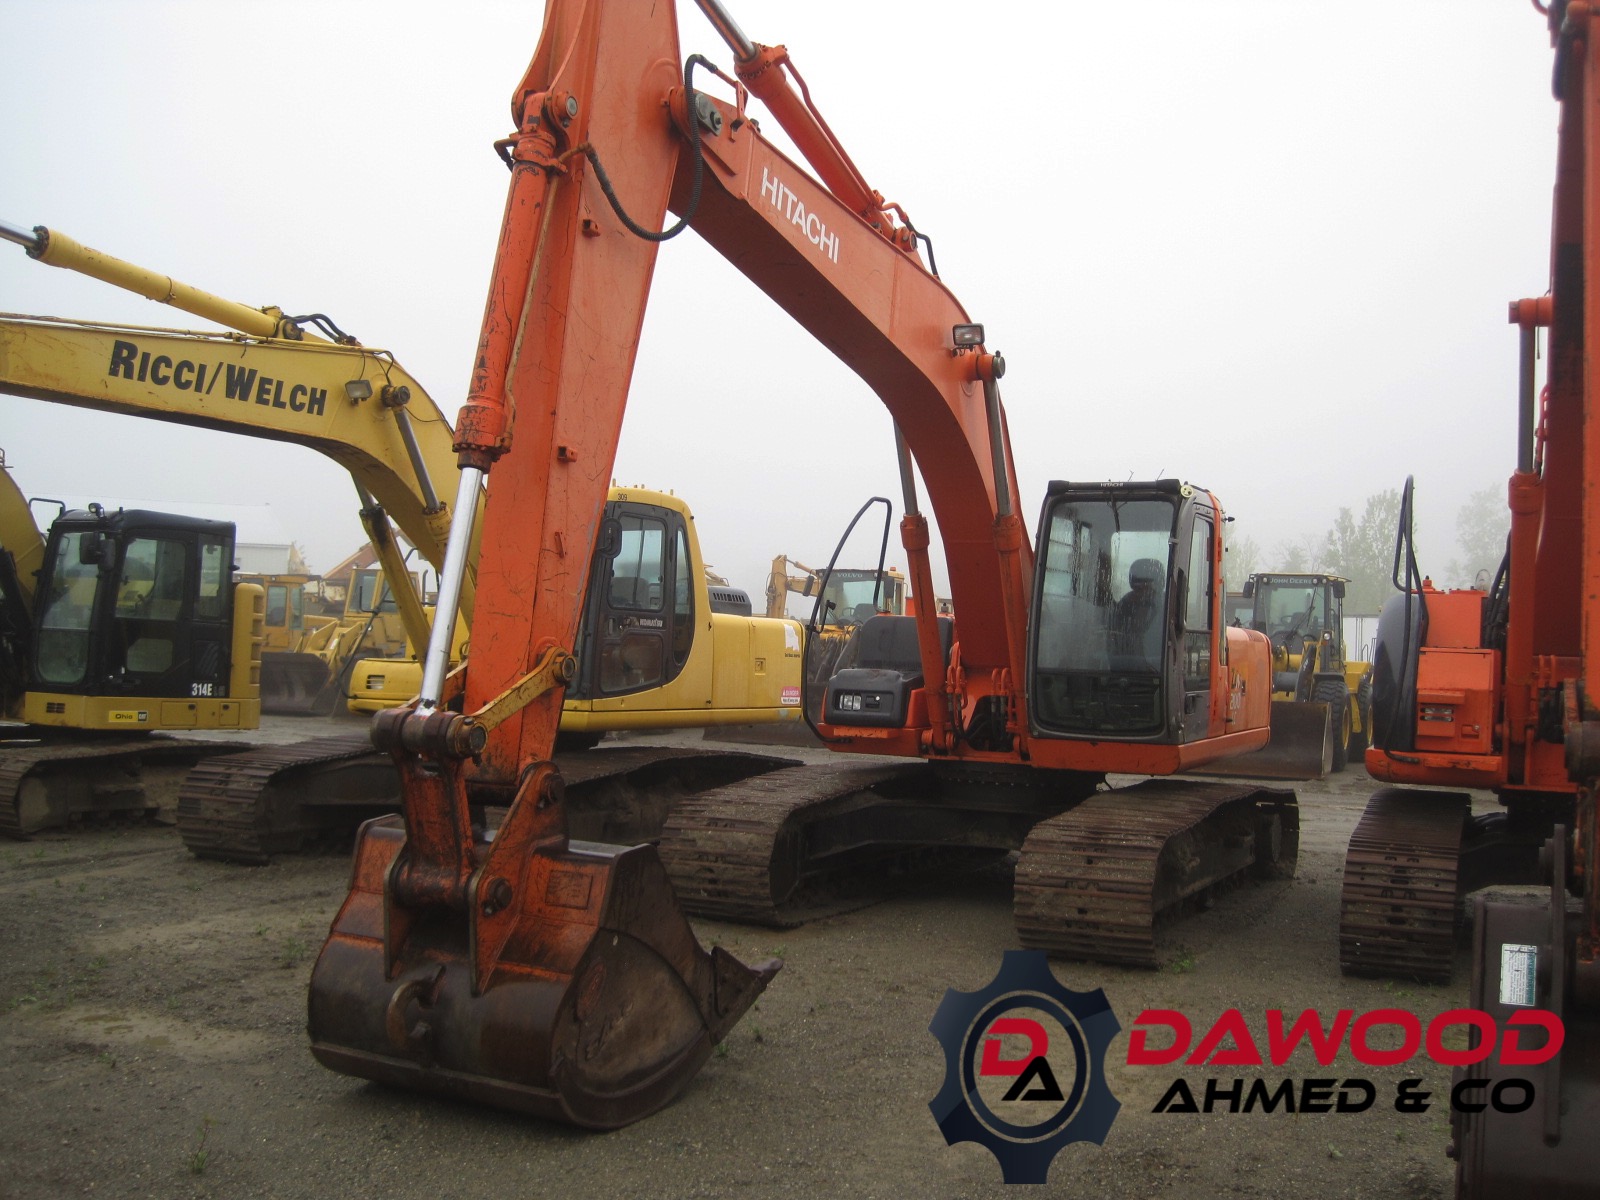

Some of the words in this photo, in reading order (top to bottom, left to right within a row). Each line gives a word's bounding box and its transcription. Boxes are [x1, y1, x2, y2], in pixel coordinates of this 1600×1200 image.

[761, 166, 840, 265] HITACHI
[108, 339, 328, 416] RICCI/WELCH
[617, 493, 628, 501] 309
[191, 683, 213, 696] 314E
